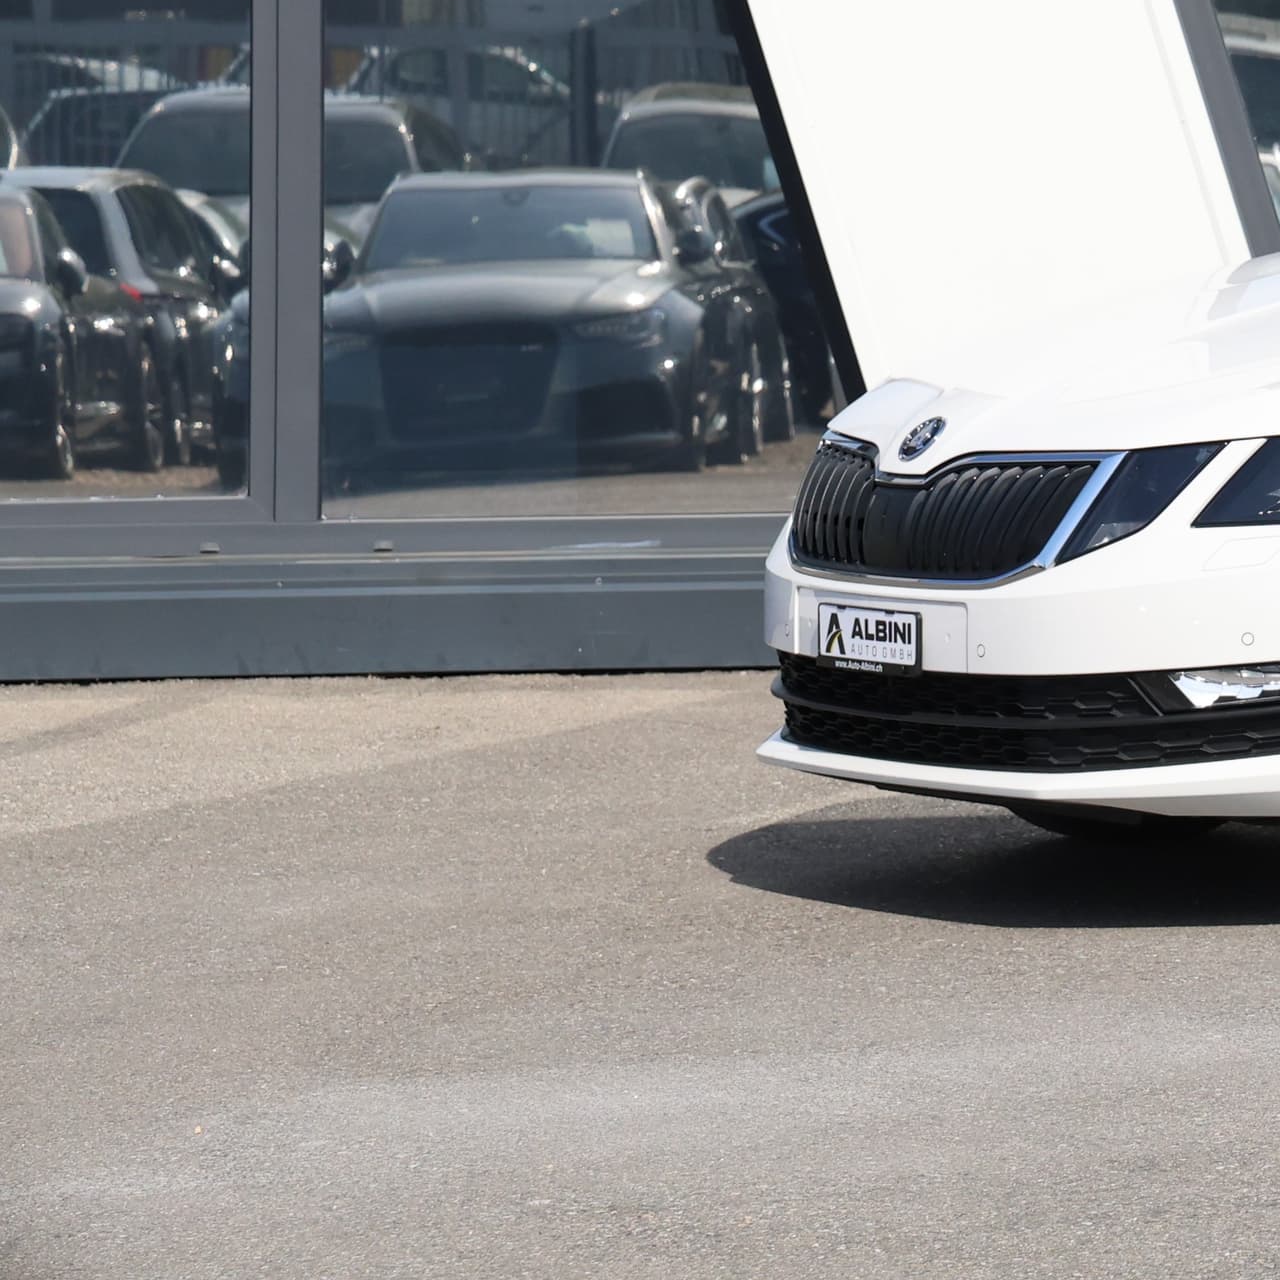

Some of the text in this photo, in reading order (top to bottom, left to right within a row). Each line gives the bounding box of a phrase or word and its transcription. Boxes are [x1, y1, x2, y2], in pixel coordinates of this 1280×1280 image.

[850, 616, 912, 645] ALBINI
[850, 643, 913, 661] AUTO GMBH
